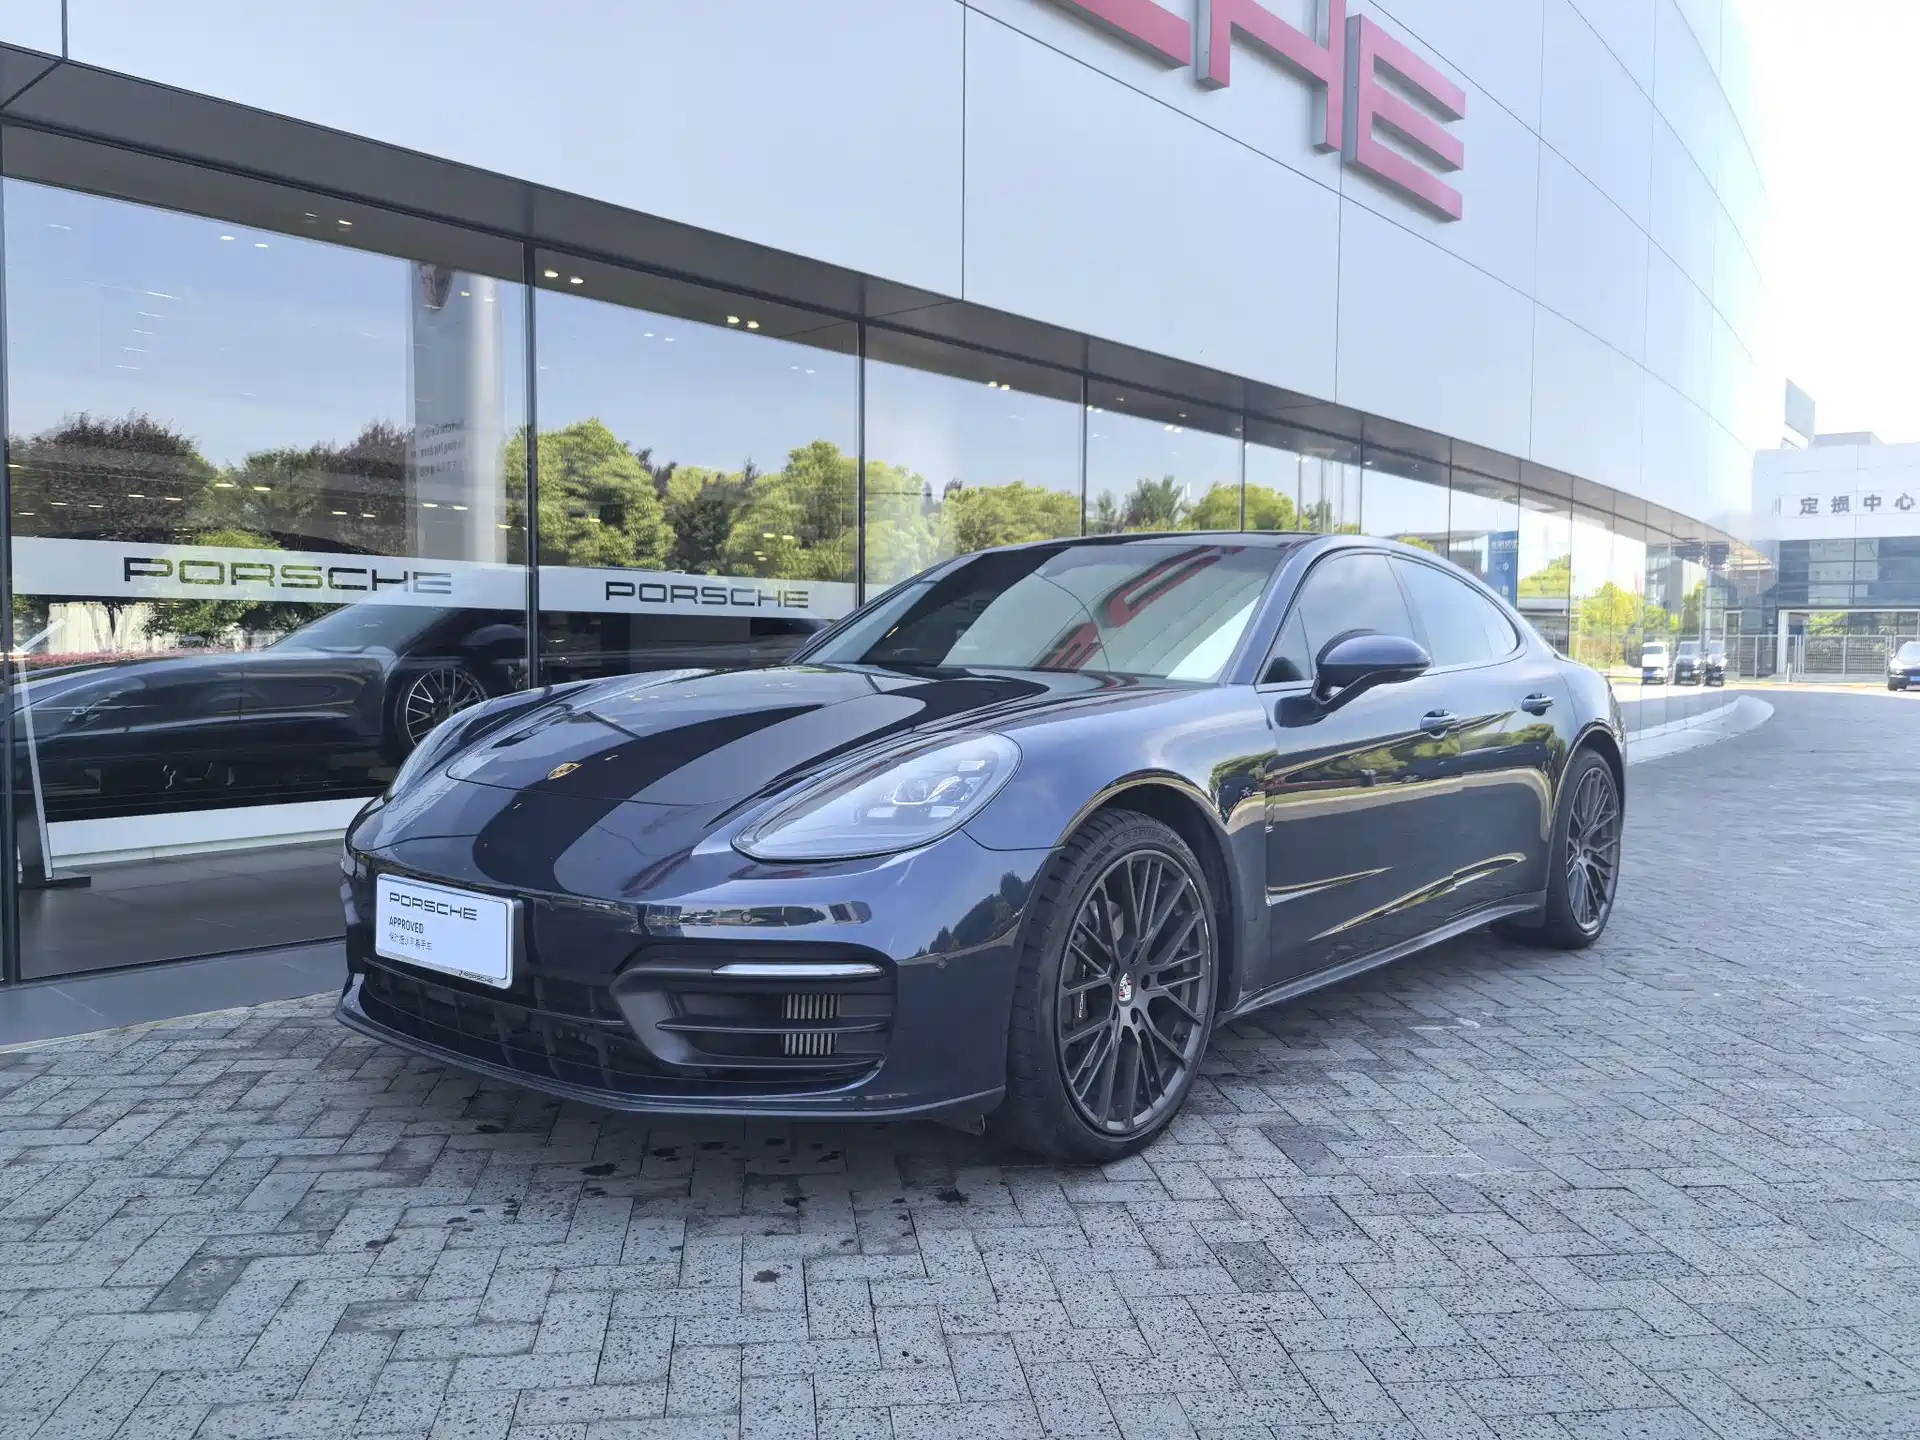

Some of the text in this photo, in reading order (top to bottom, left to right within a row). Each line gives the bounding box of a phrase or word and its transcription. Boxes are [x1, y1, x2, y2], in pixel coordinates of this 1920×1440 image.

[1055, 0, 1466, 221] HE
[1799, 493, 1915, 515] 定损中心
[123, 557, 452, 594] PORSCHE
[605, 581, 809, 608] PORSCHE
[389, 892, 477, 921] PORSCHE
[389, 915, 424, 934] APPROVED
